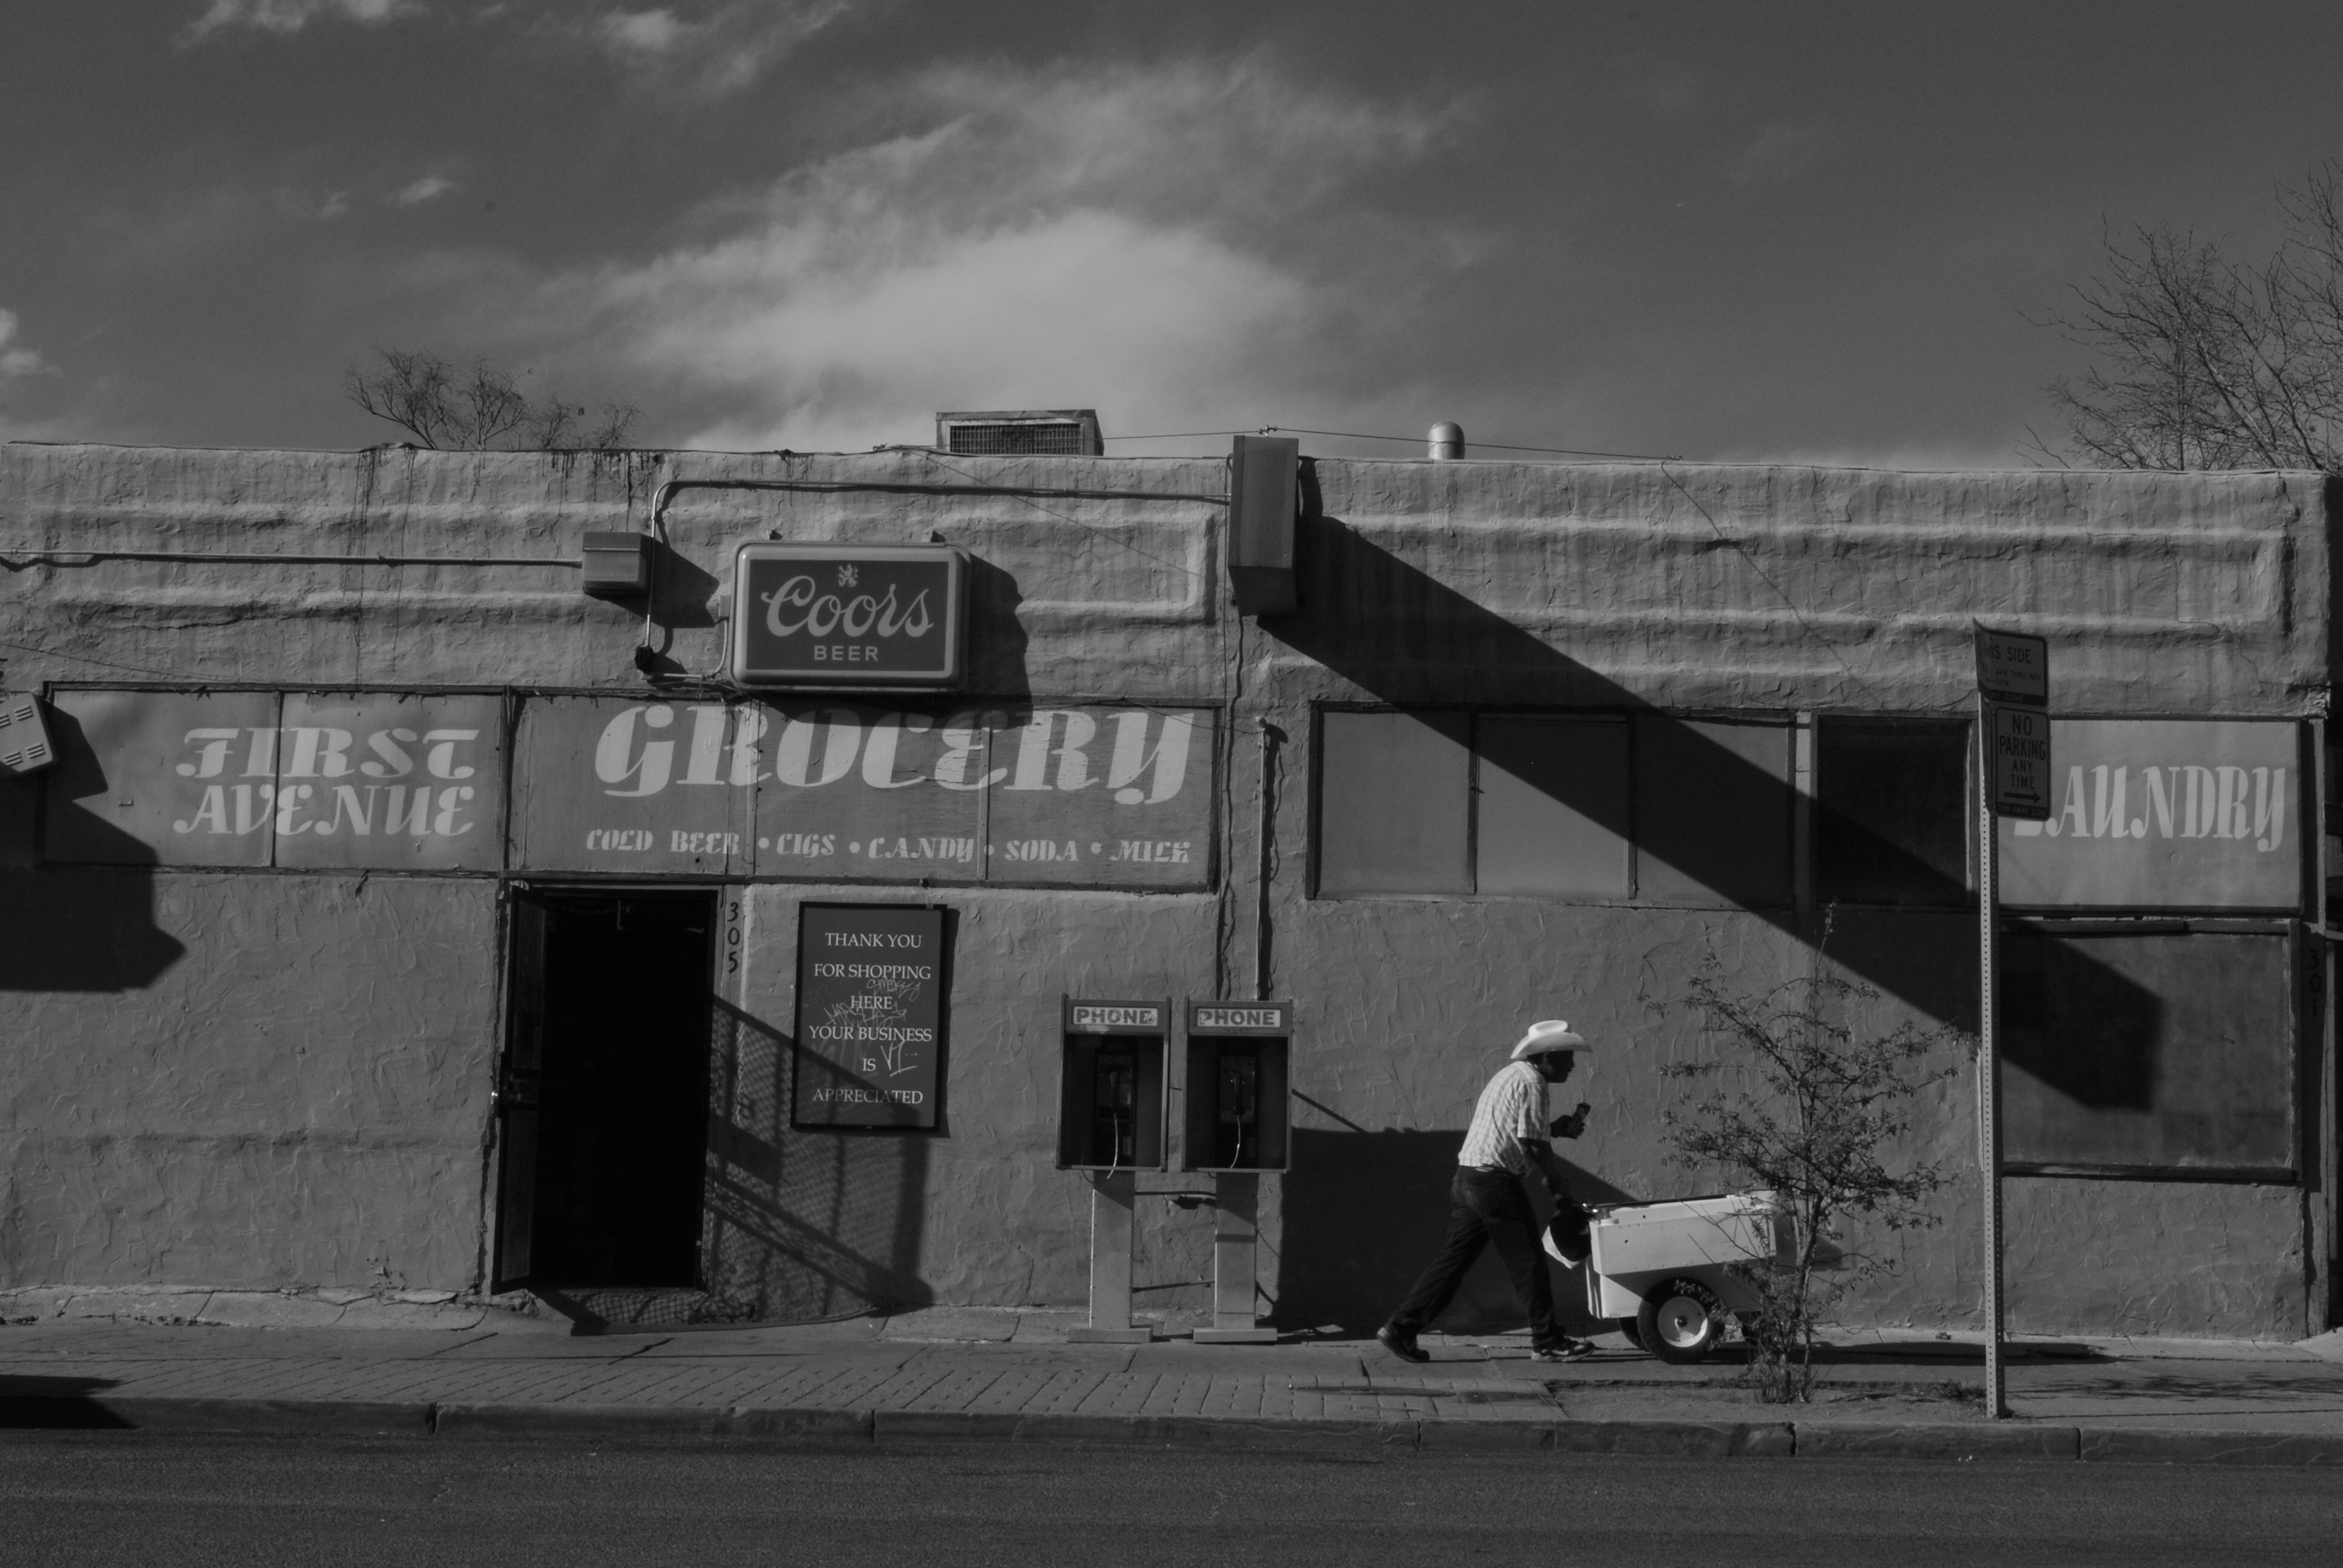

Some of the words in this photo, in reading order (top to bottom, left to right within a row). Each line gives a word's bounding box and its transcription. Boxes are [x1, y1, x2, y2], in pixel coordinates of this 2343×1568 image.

[761, 574, 935, 638] Coors
[813, 645, 879, 662] BEER
[2007, 645, 2031, 664] SIDE
[2004, 693, 2025, 703] ZONE
[2011, 714, 2033, 736] NO
[175, 727, 480, 779] FIRST
[594, 702, 1195, 805] GROCERY
[1999, 734, 2046, 761] PARKING
[2011, 759, 2034, 774] ANY
[2010, 773, 2036, 790] TIME
[172, 783, 475, 837] AVENUE
[2012, 805, 2028, 815] AWAY
[2014, 764, 2286, 852] AUNDRY
[586, 829, 653, 852] COLD
[669, 830, 741, 855] BEER
[776, 832, 836, 857] CIGS
[867, 836, 975, 863] CANDY
[1004, 838, 1080, 863] SODA
[1109, 838, 1191, 864] MILK
[727, 901, 741, 973] 305
[825, 932, 883, 948] THANK
[886, 933, 922, 949] YOU
[814, 963, 845, 978] FOR
[848, 964, 931, 980] SHOPPING
[850, 995, 893, 1010] HERE
[1076, 1008, 1153, 1024] PHONE
[1198, 1010, 1275, 1025] PHONE
[809, 1025, 854, 1040] YOUR
[858, 1027, 932, 1042] BUSINESS
[862, 1057, 877, 1071] IS
[813, 1088, 923, 1104] APPRECIATED
